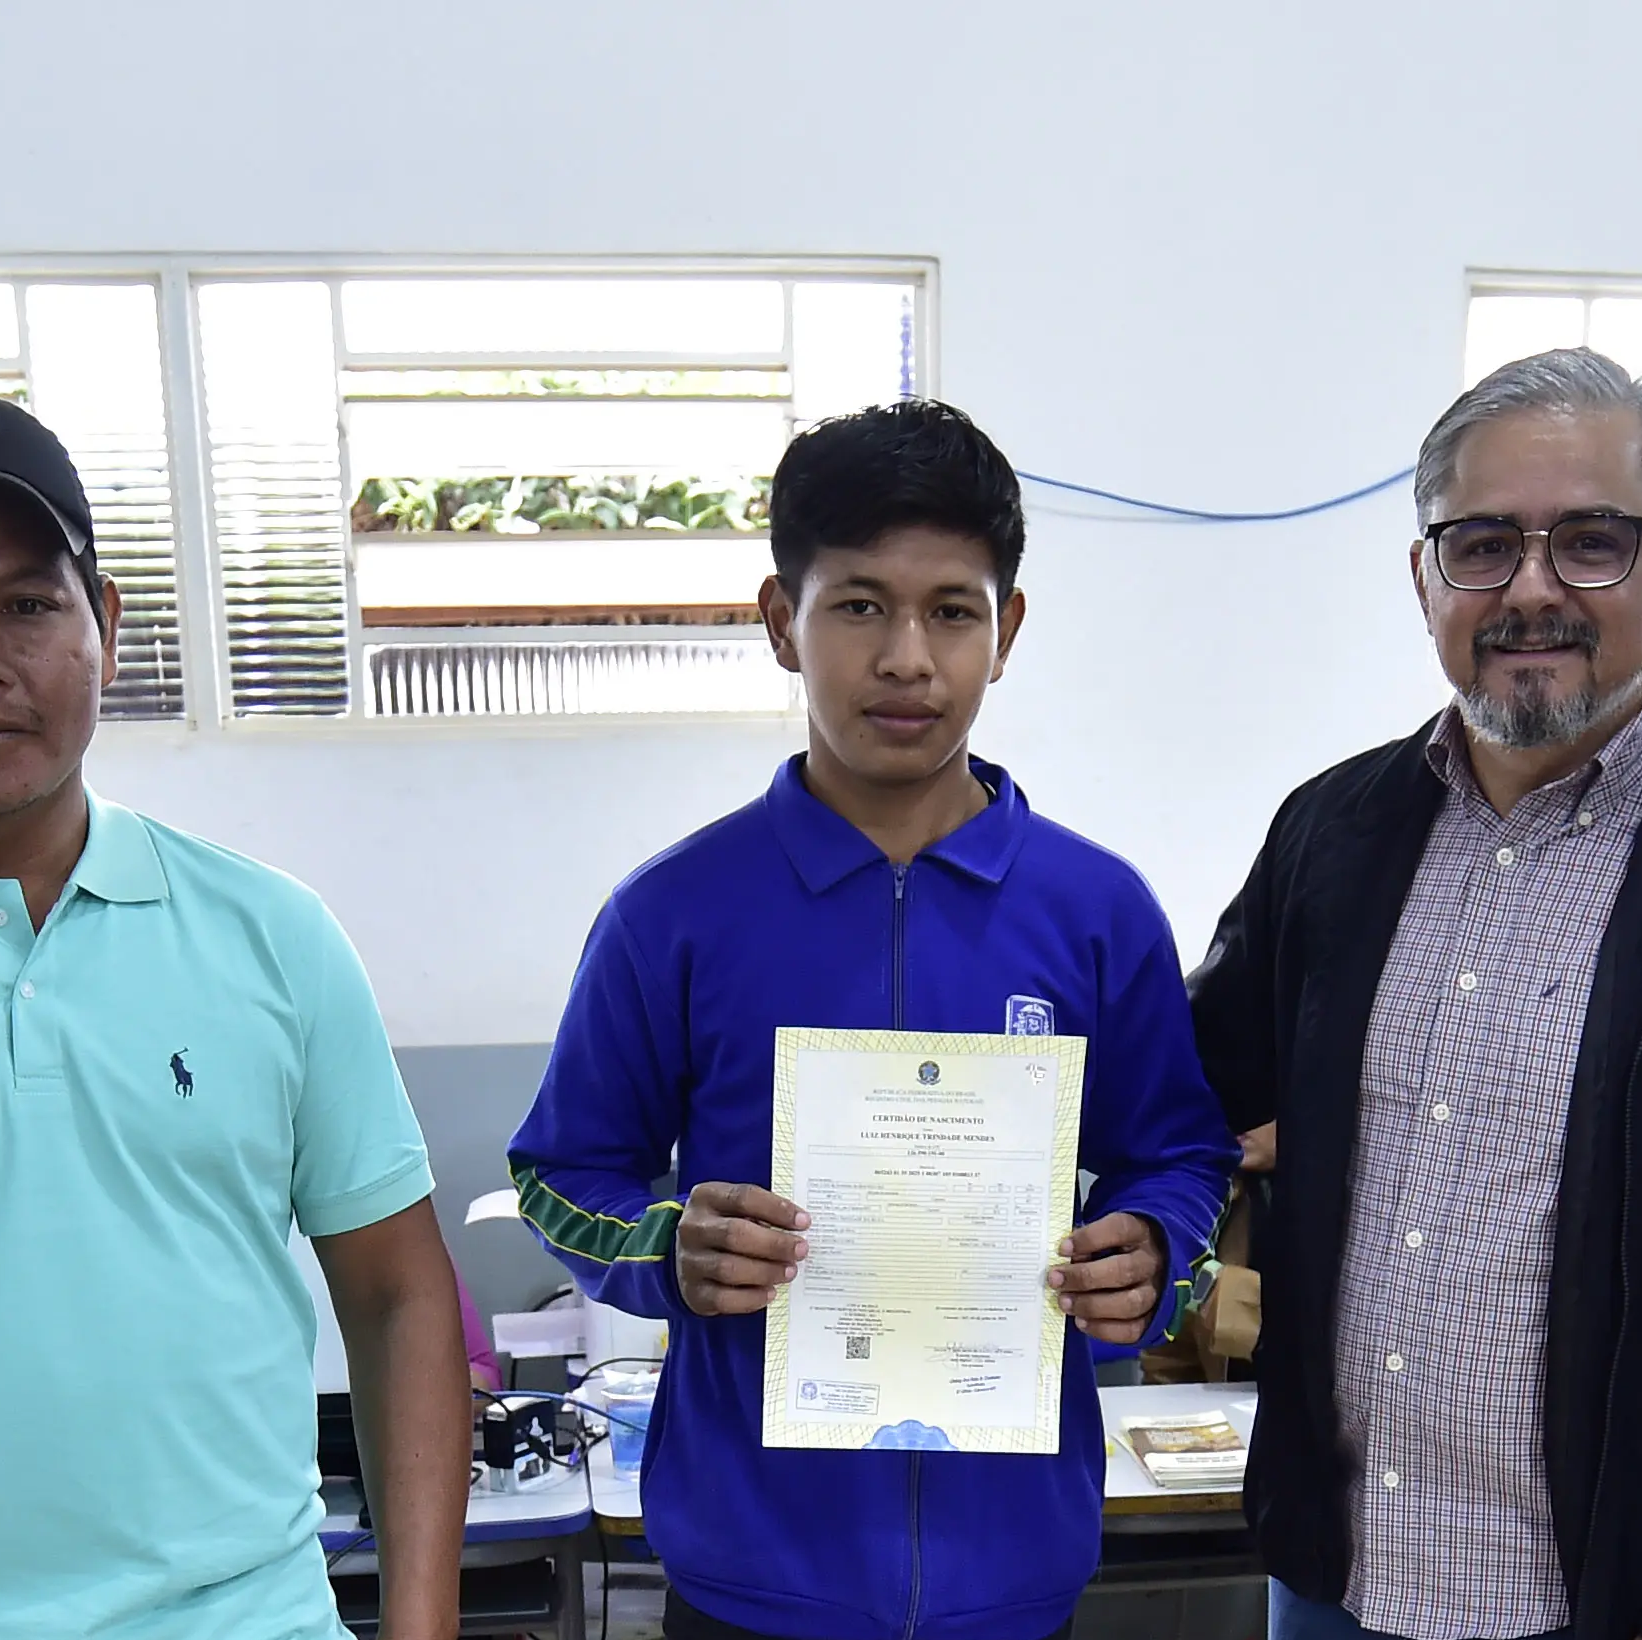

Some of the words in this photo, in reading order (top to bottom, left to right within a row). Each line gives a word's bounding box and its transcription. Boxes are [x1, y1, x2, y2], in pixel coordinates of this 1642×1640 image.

[872, 1113, 916, 1124] CERTIDÃO
[917, 1115, 928, 1124] DE
[930, 1115, 985, 1126] NASCIMENTO
